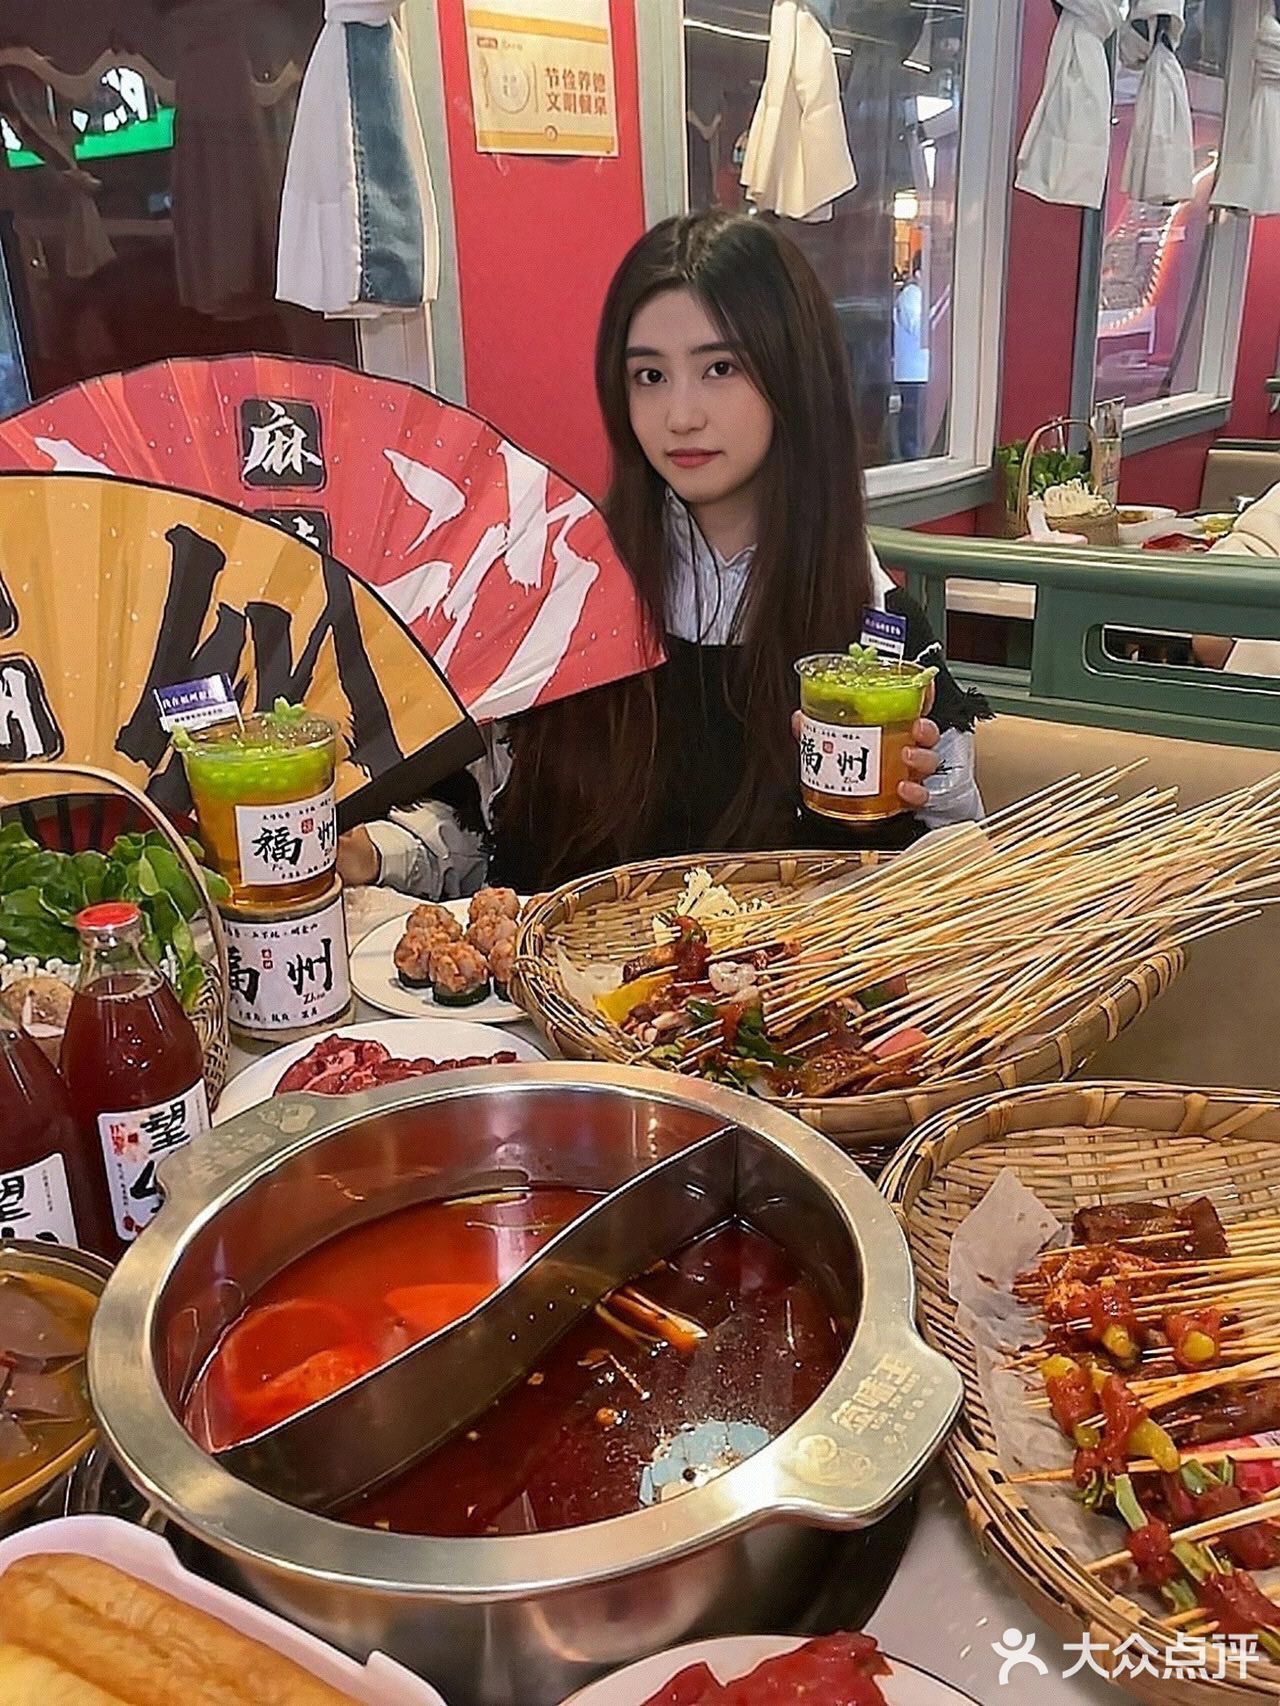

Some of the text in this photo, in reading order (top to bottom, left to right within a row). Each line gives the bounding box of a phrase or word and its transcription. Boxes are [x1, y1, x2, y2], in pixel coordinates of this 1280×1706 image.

[546, 91, 607, 115] 文明餐桌
[242, 400, 322, 476] 麻
[800, 733, 869, 781] 福州
[251, 807, 335, 866] 福州
